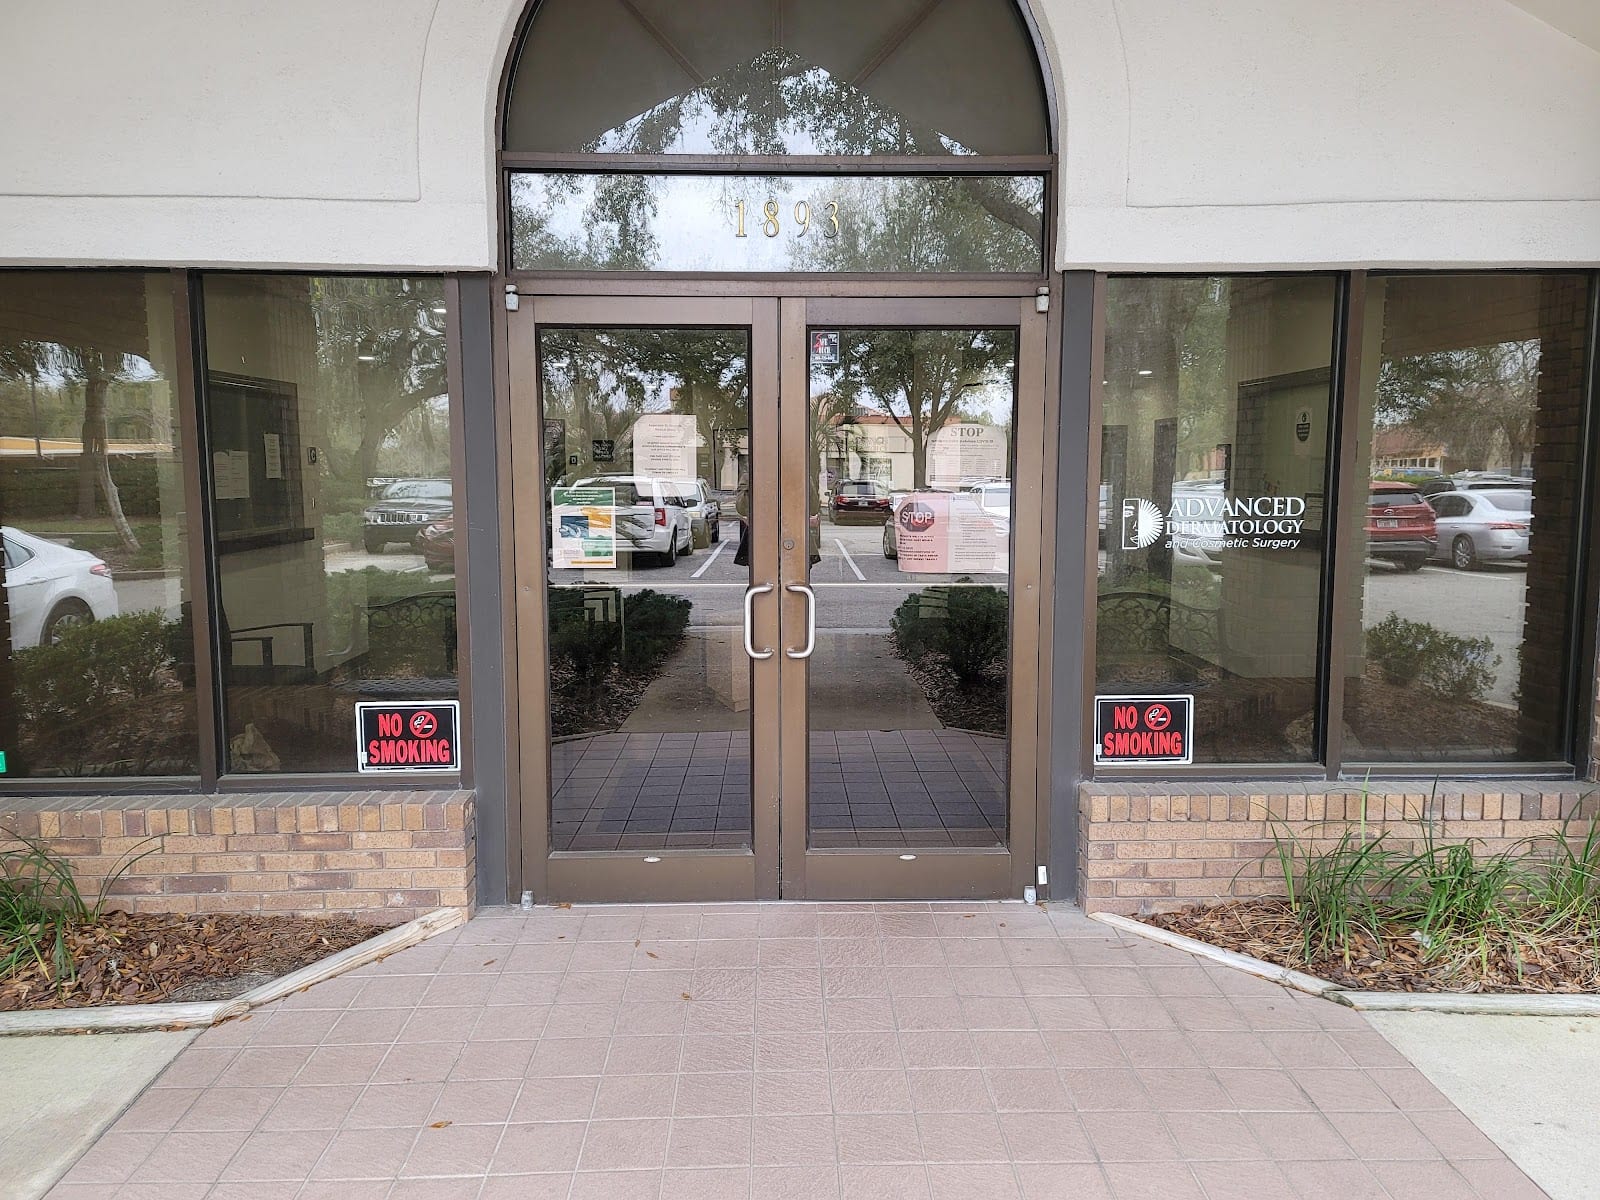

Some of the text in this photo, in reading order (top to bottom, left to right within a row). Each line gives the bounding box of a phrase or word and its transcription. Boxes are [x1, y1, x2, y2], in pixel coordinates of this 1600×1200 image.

[735, 199, 840, 238] 1893
[950, 427, 984, 437] STOP
[901, 511, 932, 524] STOP
[1165, 496, 1306, 518] ADVANCED
[1165, 519, 1305, 535] DERMATOLOGY
[1164, 537, 1301, 550] and Cosmetic Surgery
[377, 712, 403, 738] NO
[1113, 705, 1138, 730] NO
[368, 738, 450, 764] SMOKING
[1103, 731, 1183, 756] SMOKING
